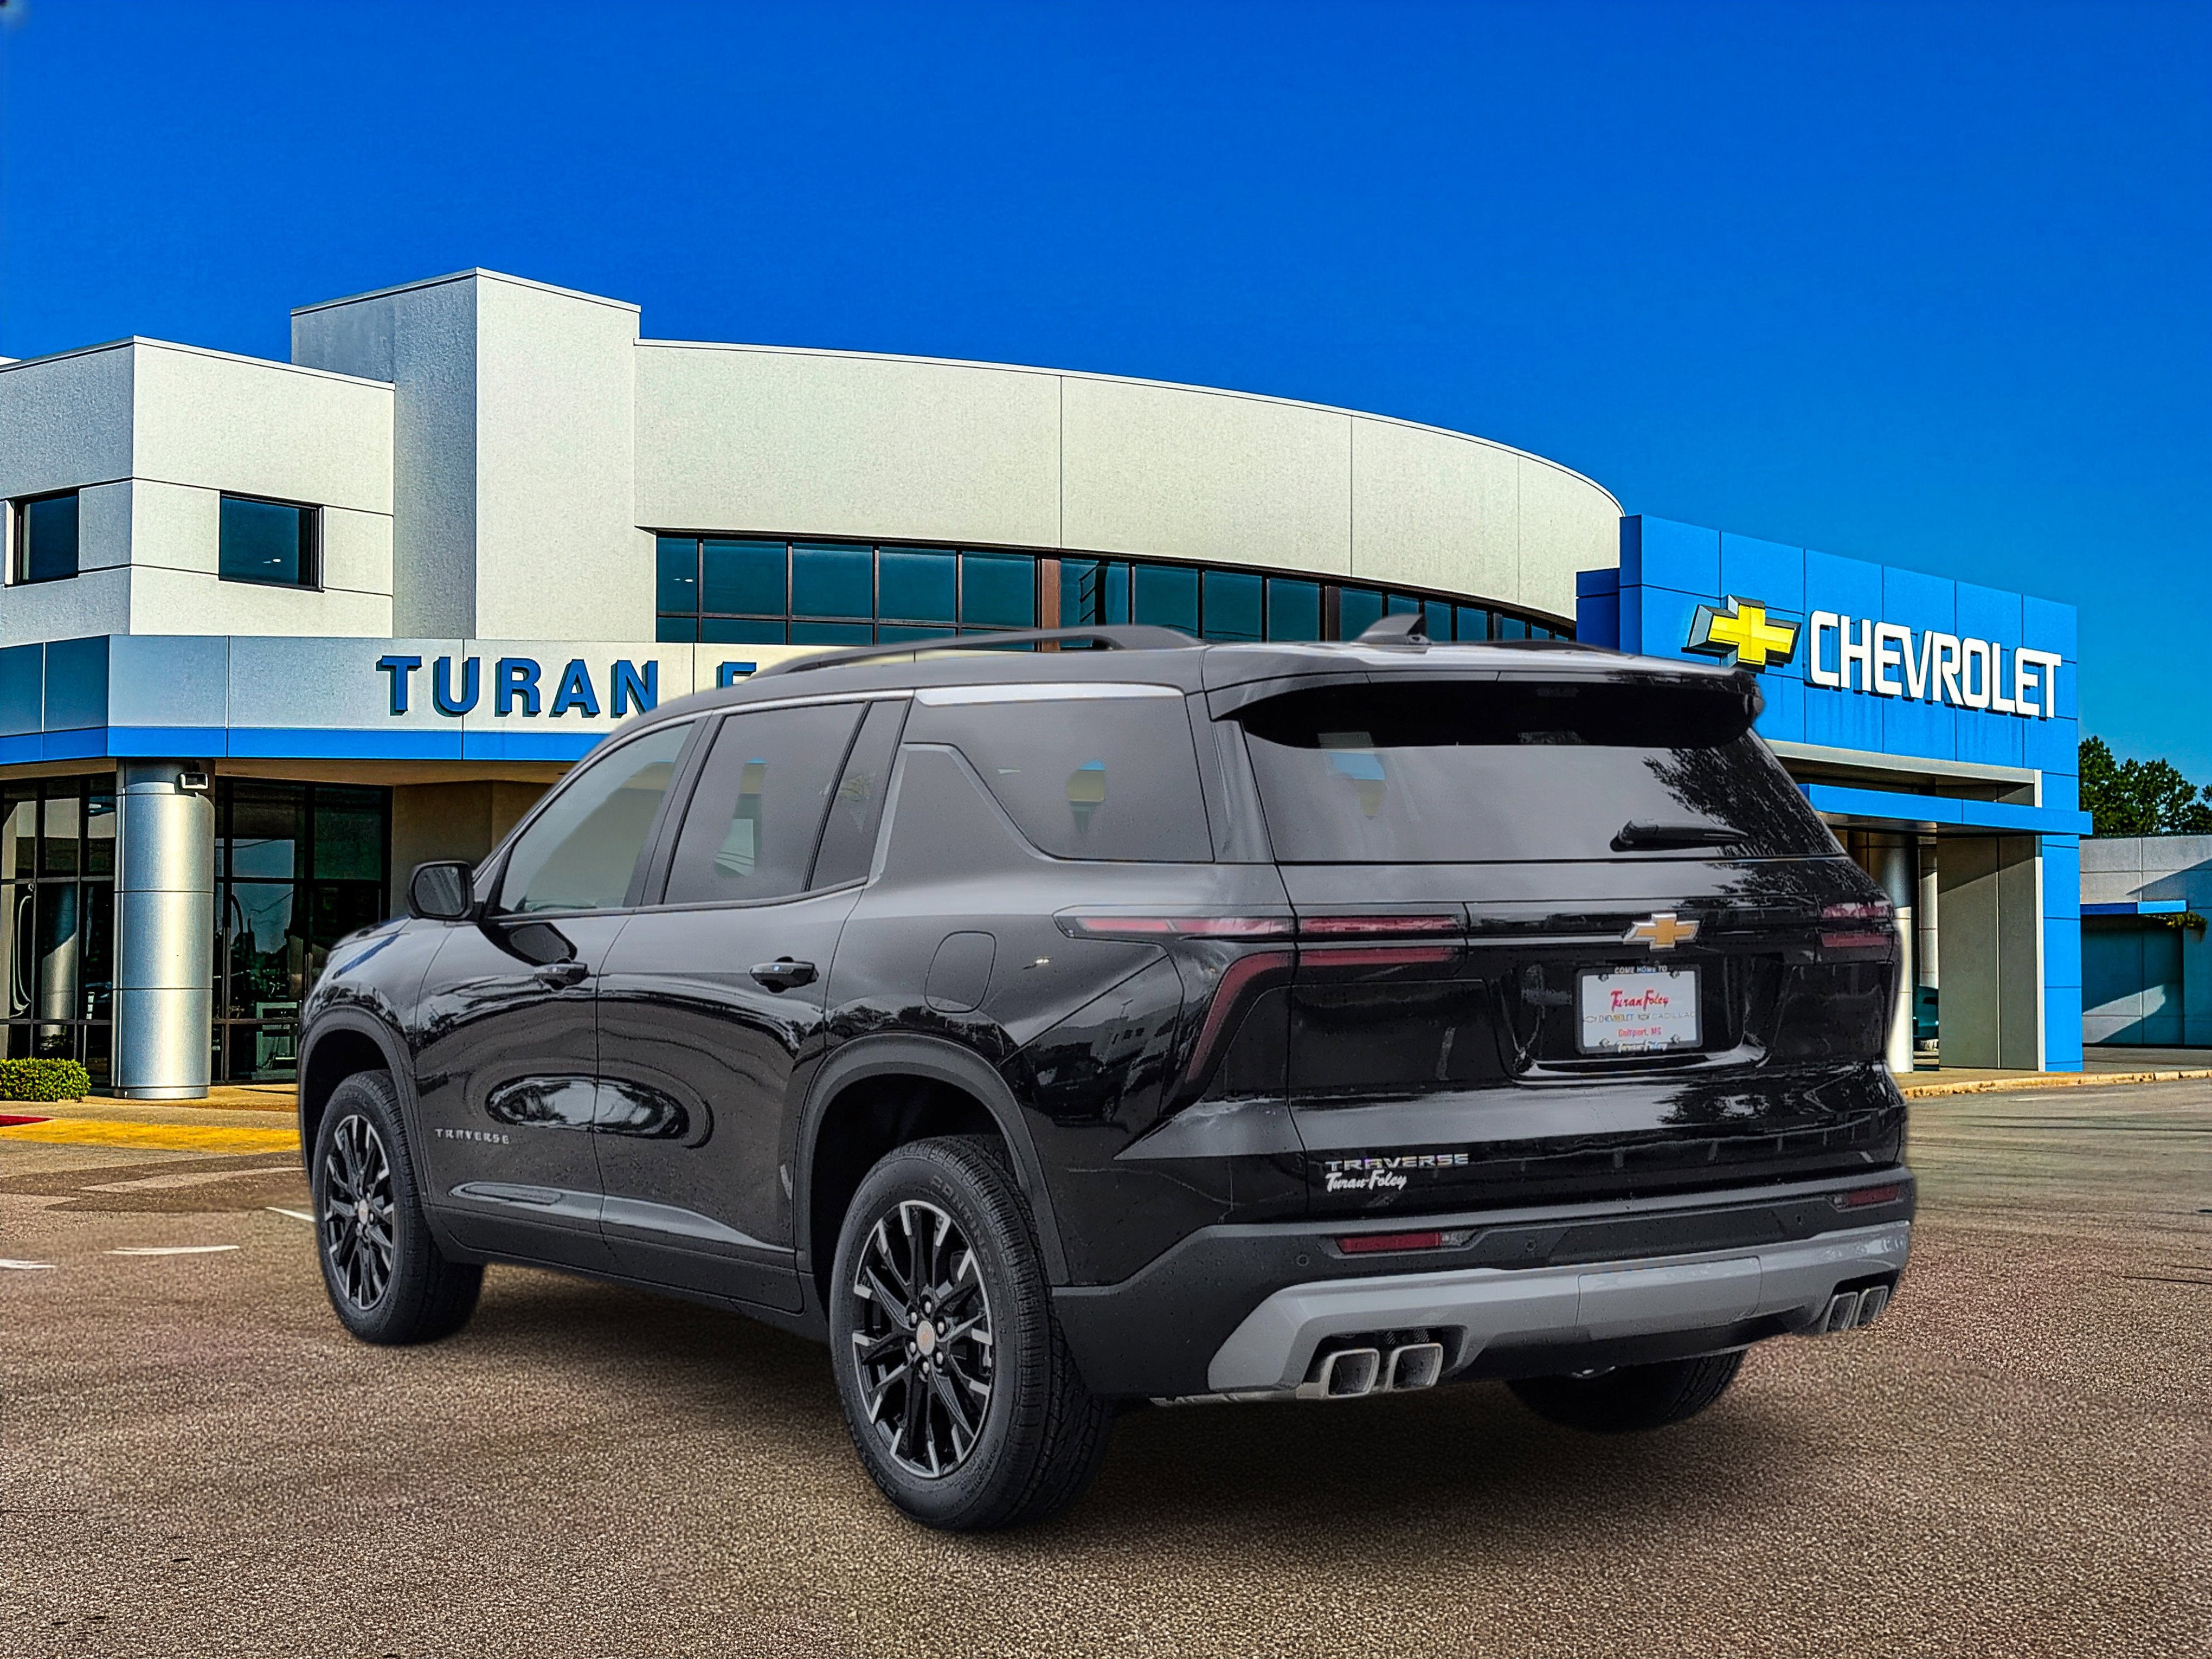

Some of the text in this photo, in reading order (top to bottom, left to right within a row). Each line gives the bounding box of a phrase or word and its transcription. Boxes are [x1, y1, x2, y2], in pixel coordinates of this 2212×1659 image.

[1810, 610, 2062, 718] CHEVROLET
[376, 655, 658, 718] TURAN
[434, 1128, 510, 1144] TRAVERSE
[1325, 1153, 1469, 1172] TRAVERSE
